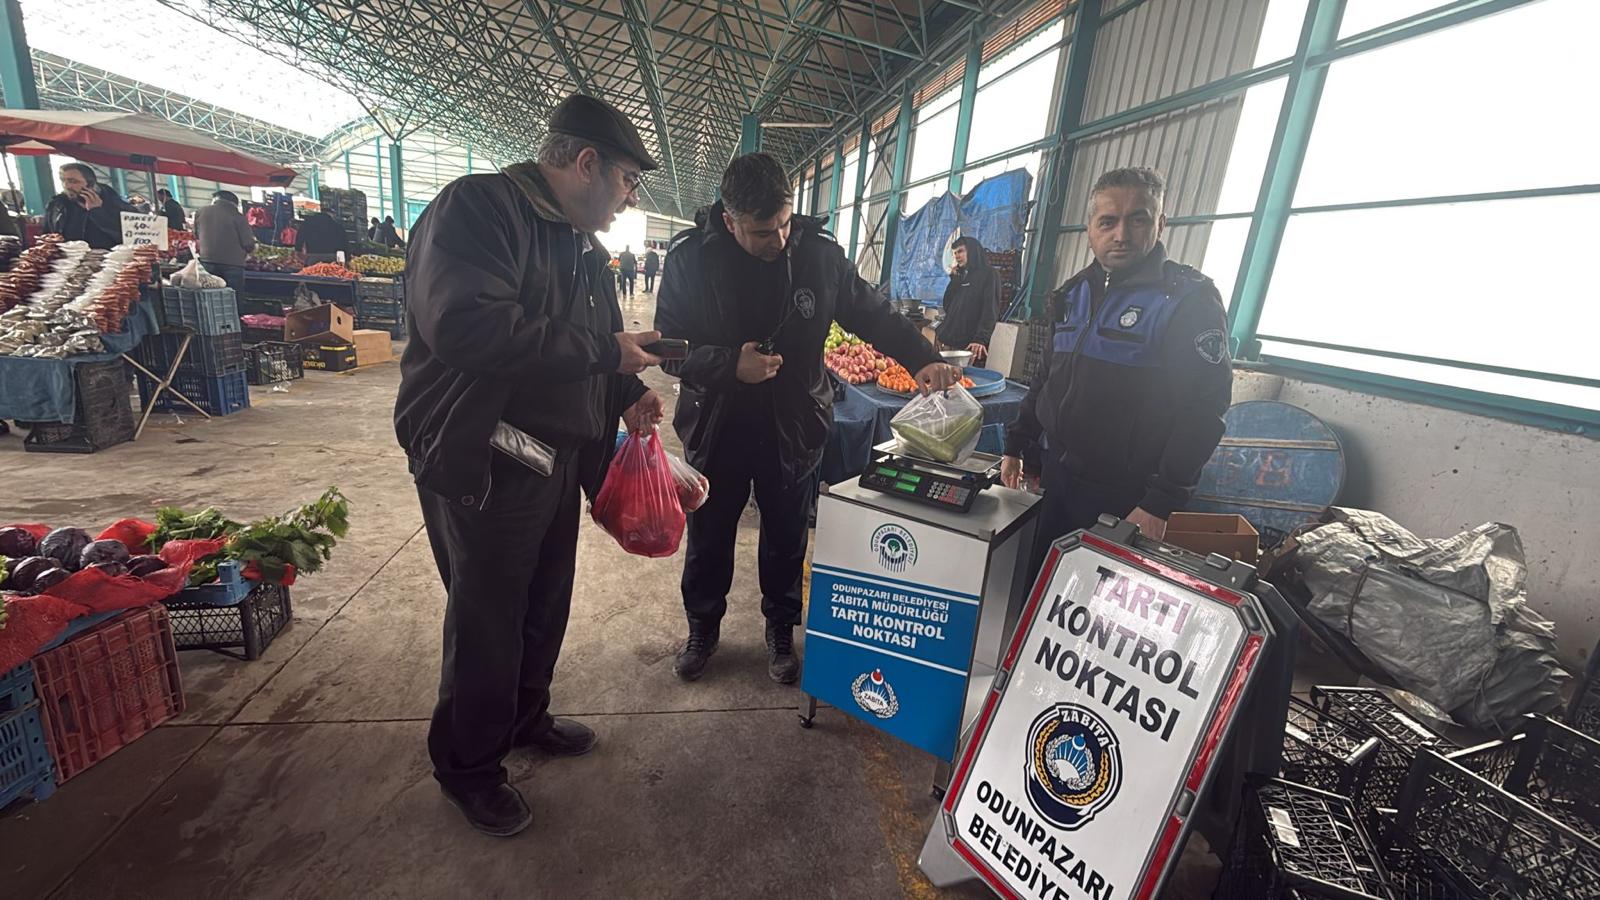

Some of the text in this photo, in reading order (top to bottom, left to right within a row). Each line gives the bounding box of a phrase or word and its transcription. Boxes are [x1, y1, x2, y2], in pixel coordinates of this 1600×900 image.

[873, 526, 897, 553] ODUNPAZARI
[831, 592, 949, 624] ZABITA MÜDÜRLÜĞÜ
[832, 583, 950, 611] ODUNPAZARI BELEDİYESİ
[1093, 565, 1191, 634] TARTI
[831, 605, 946, 641] TARTI KONTROL
[853, 625, 917, 649] NOKTASI
[1046, 594, 1199, 700] KONTROL
[864, 692, 884, 706] ZABITA
[1034, 636, 1181, 742] NOKTASI
[1060, 709, 1111, 749] ZABITA
[976, 780, 1115, 900] ODUNPAZARI
